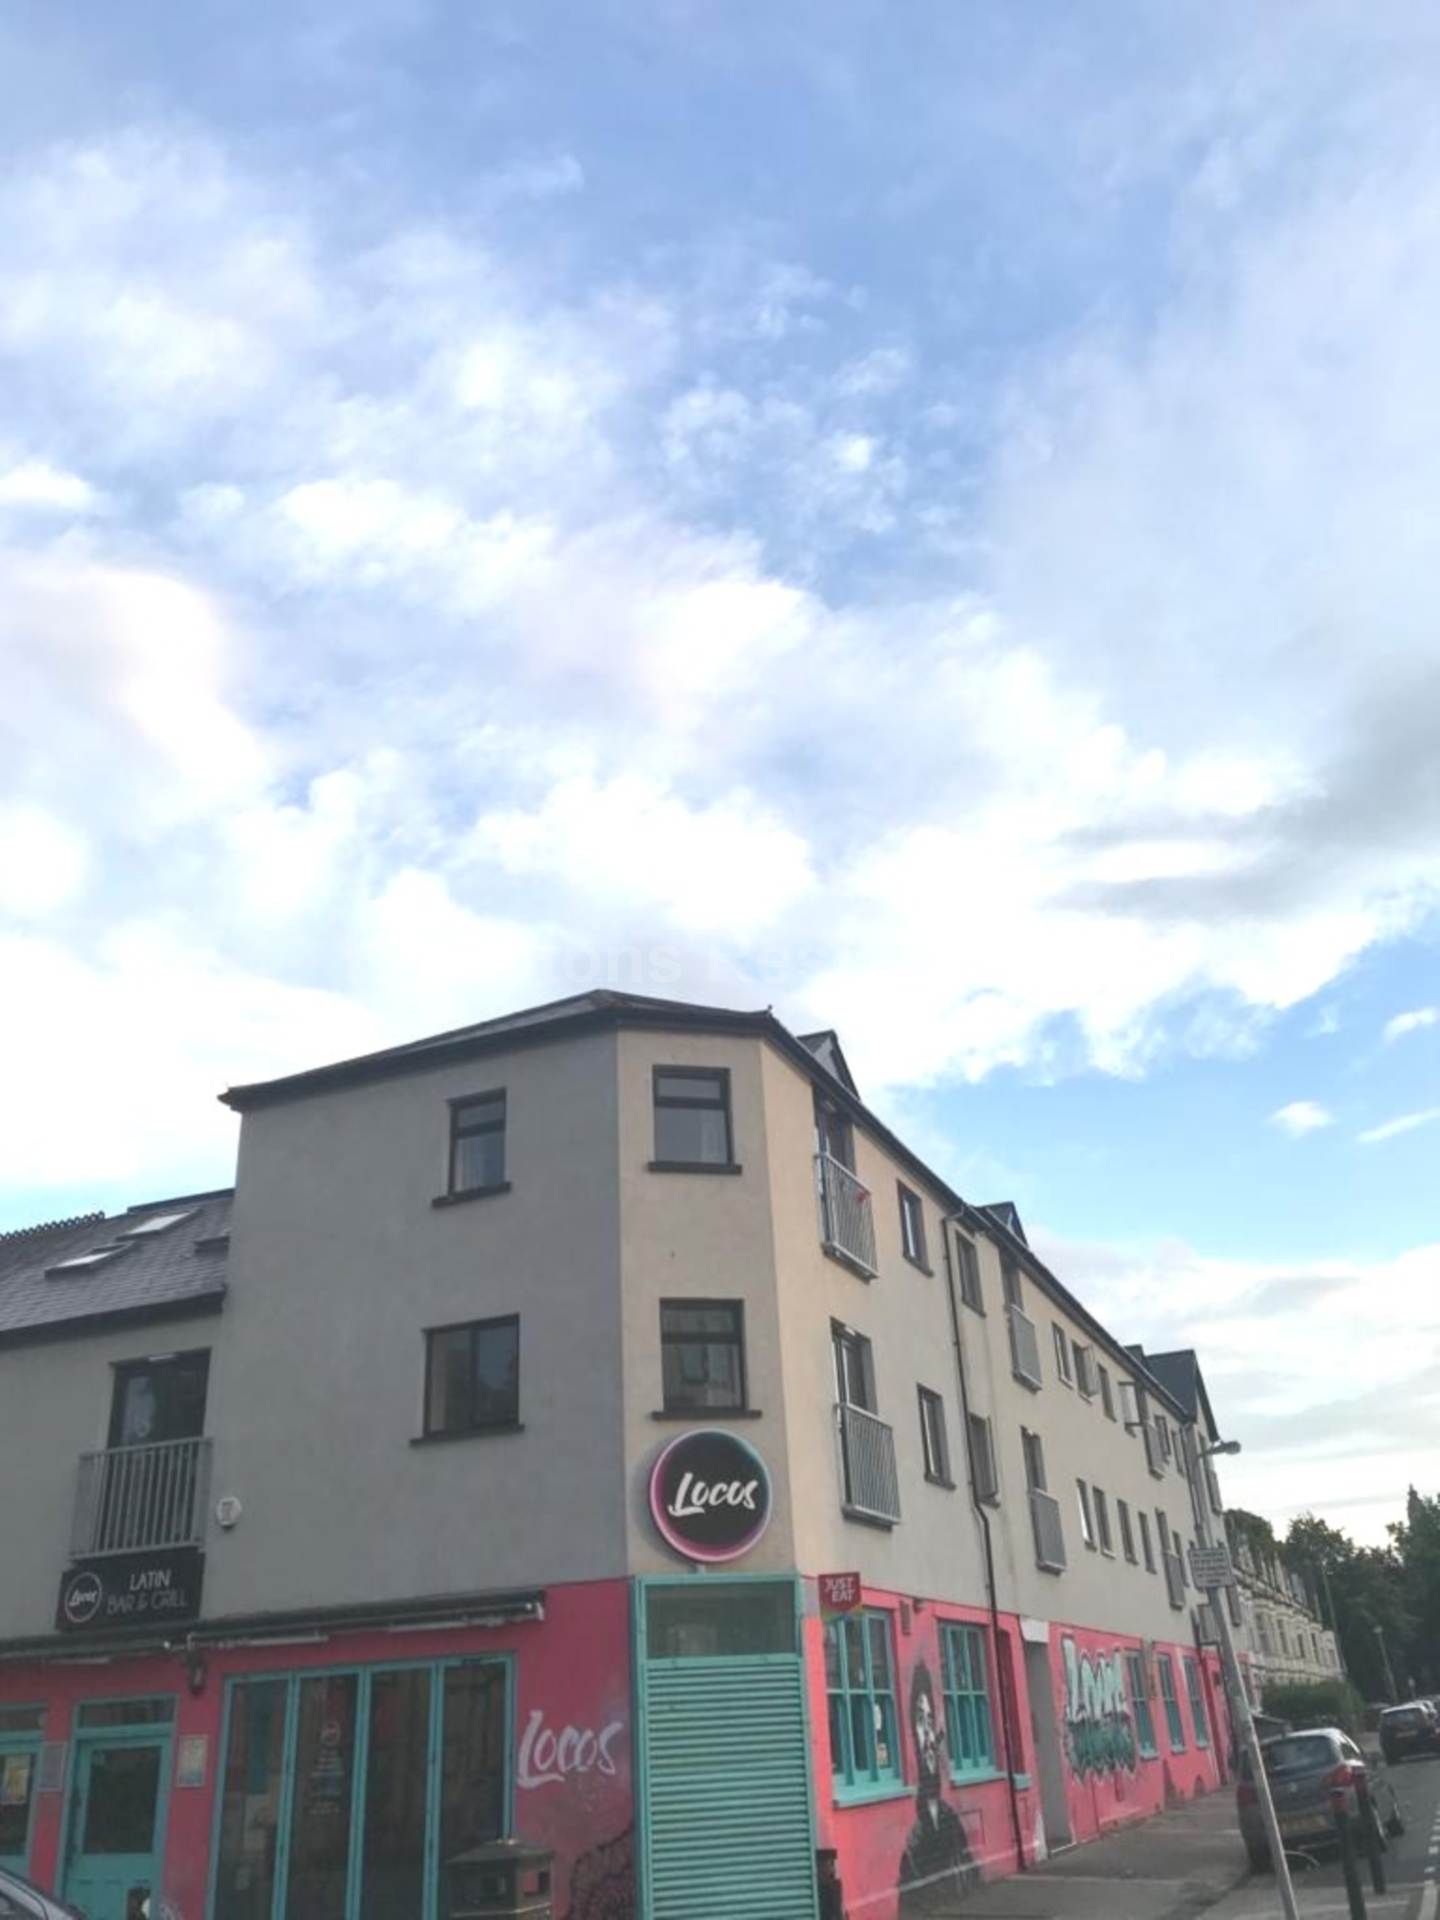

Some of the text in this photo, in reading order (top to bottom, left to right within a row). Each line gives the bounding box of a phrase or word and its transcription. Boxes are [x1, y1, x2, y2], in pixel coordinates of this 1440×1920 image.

[667, 1471, 758, 1517] Locos
[129, 1568, 172, 1591] LATIN
[824, 1577, 855, 1592] JUST
[106, 1593, 134, 1615] BAR
[151, 1588, 188, 1610] GRILL
[831, 1589, 855, 1602] EAT
[517, 1709, 624, 1789] Locos
